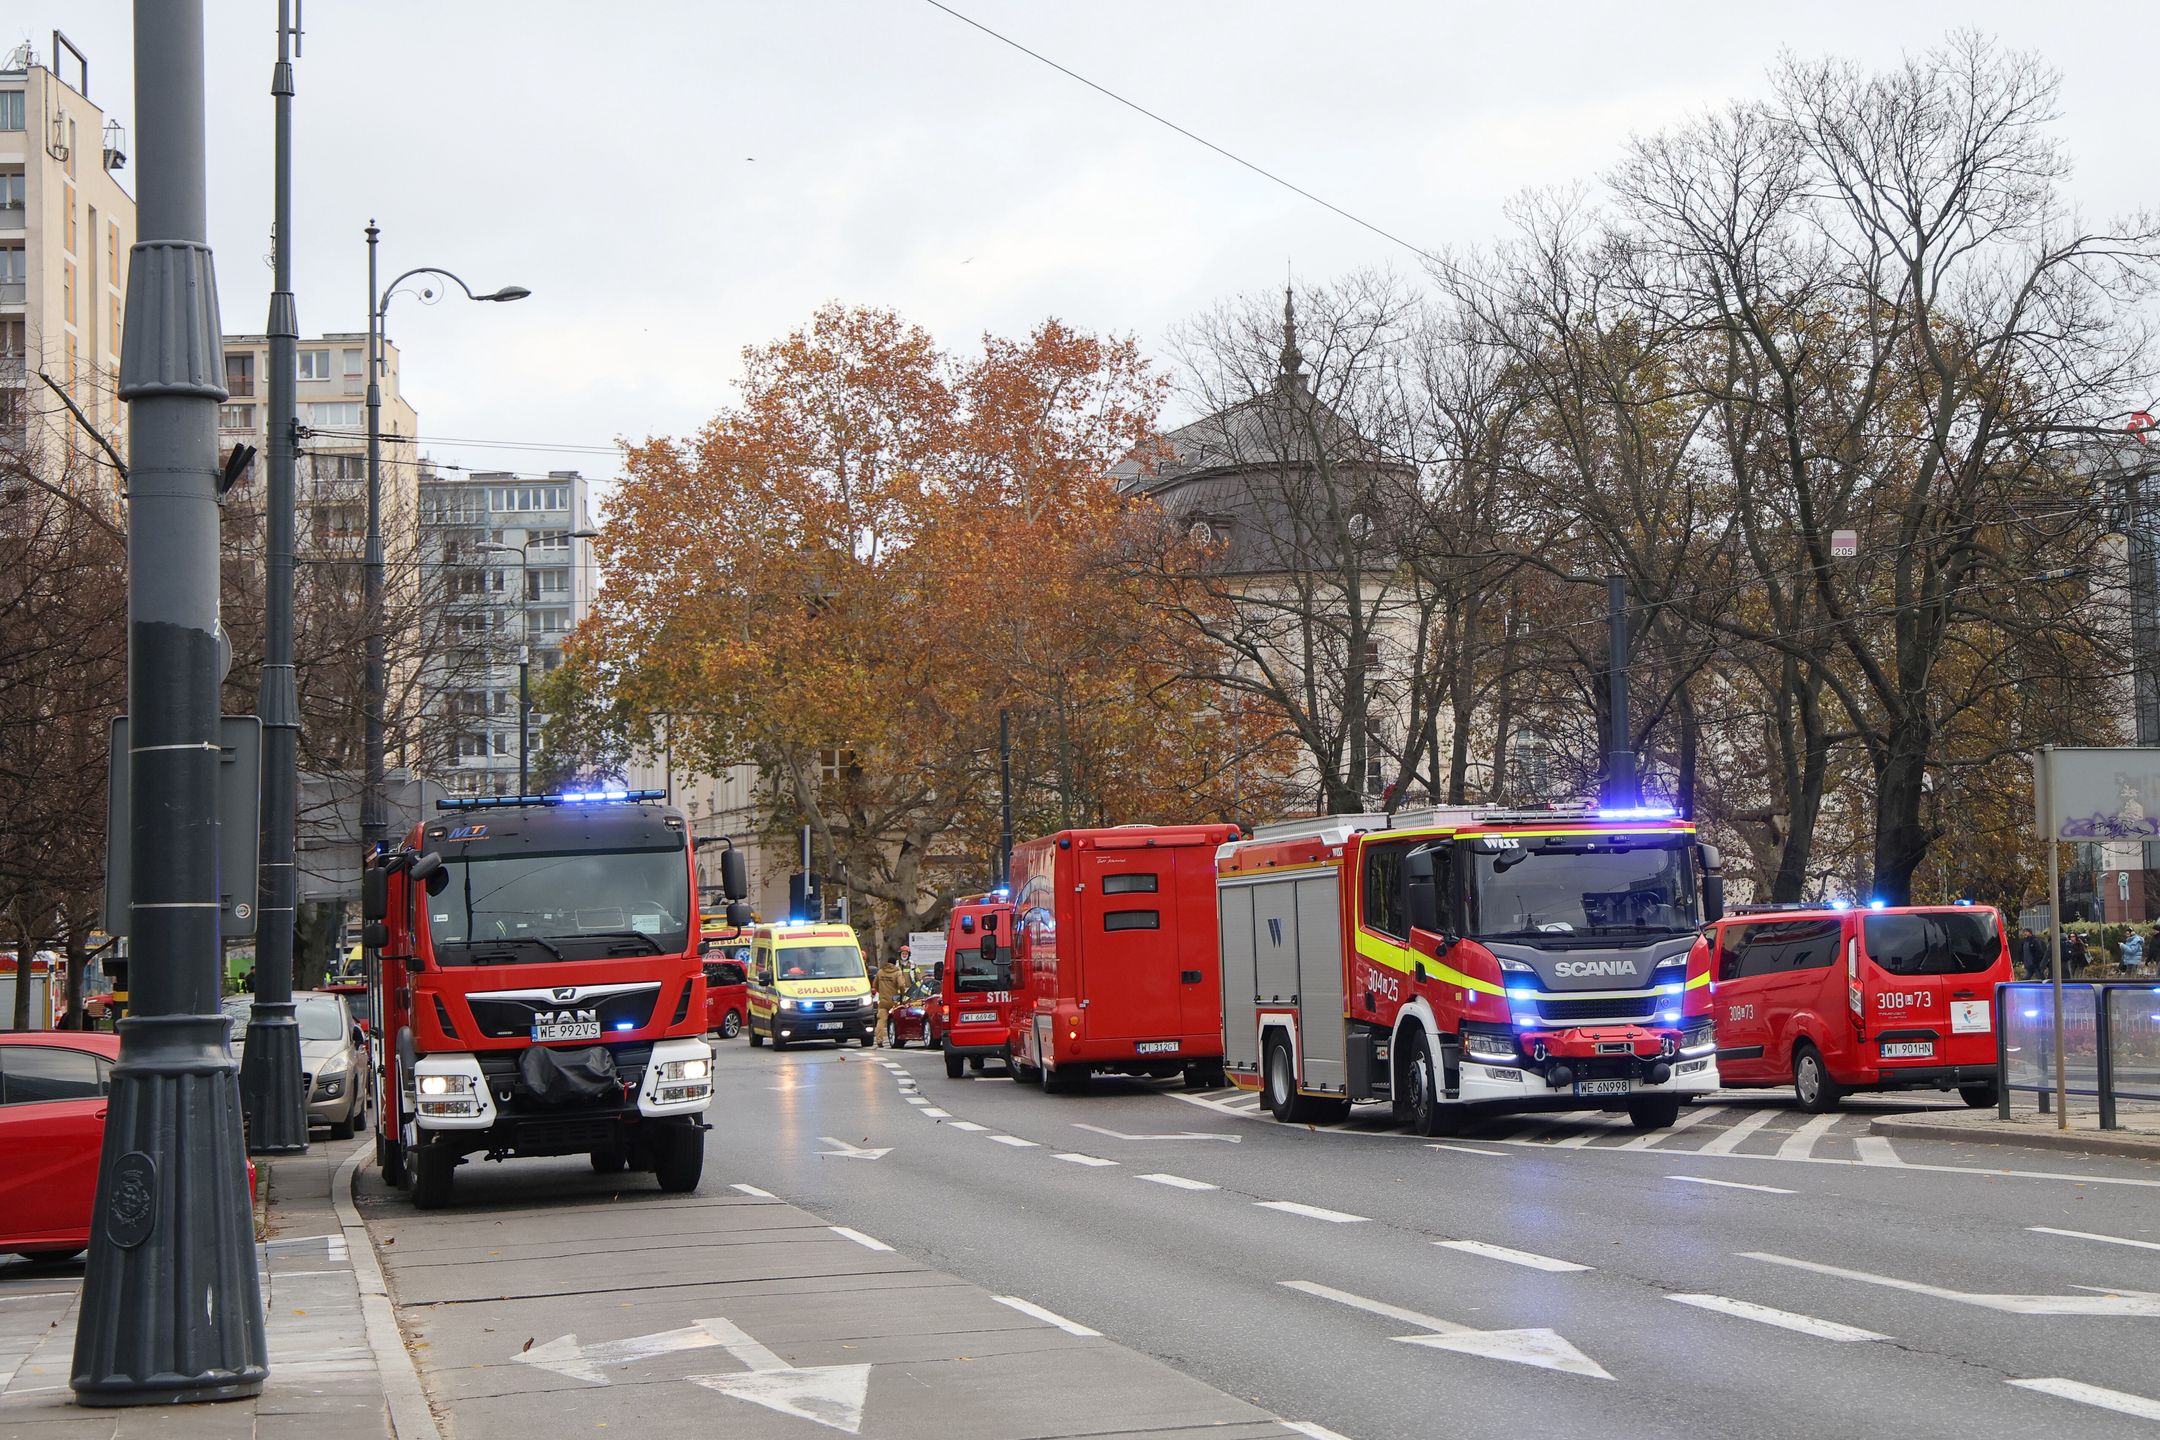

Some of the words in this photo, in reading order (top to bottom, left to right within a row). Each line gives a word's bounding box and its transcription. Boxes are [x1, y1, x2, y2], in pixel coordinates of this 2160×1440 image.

[1835, 548, 1853, 556] 205
[1555, 960, 1638, 978] SCANIA
[534, 1009, 597, 1025] MAN
[540, 1025, 556, 1039] WE
[560, 1022, 599, 1037] 992VS
[1886, 1044, 1898, 1055] WI
[1901, 1043, 1932, 1055] 901HN
[1580, 1082, 1594, 1093] WE
[1597, 1081, 1628, 1093] 6N998
